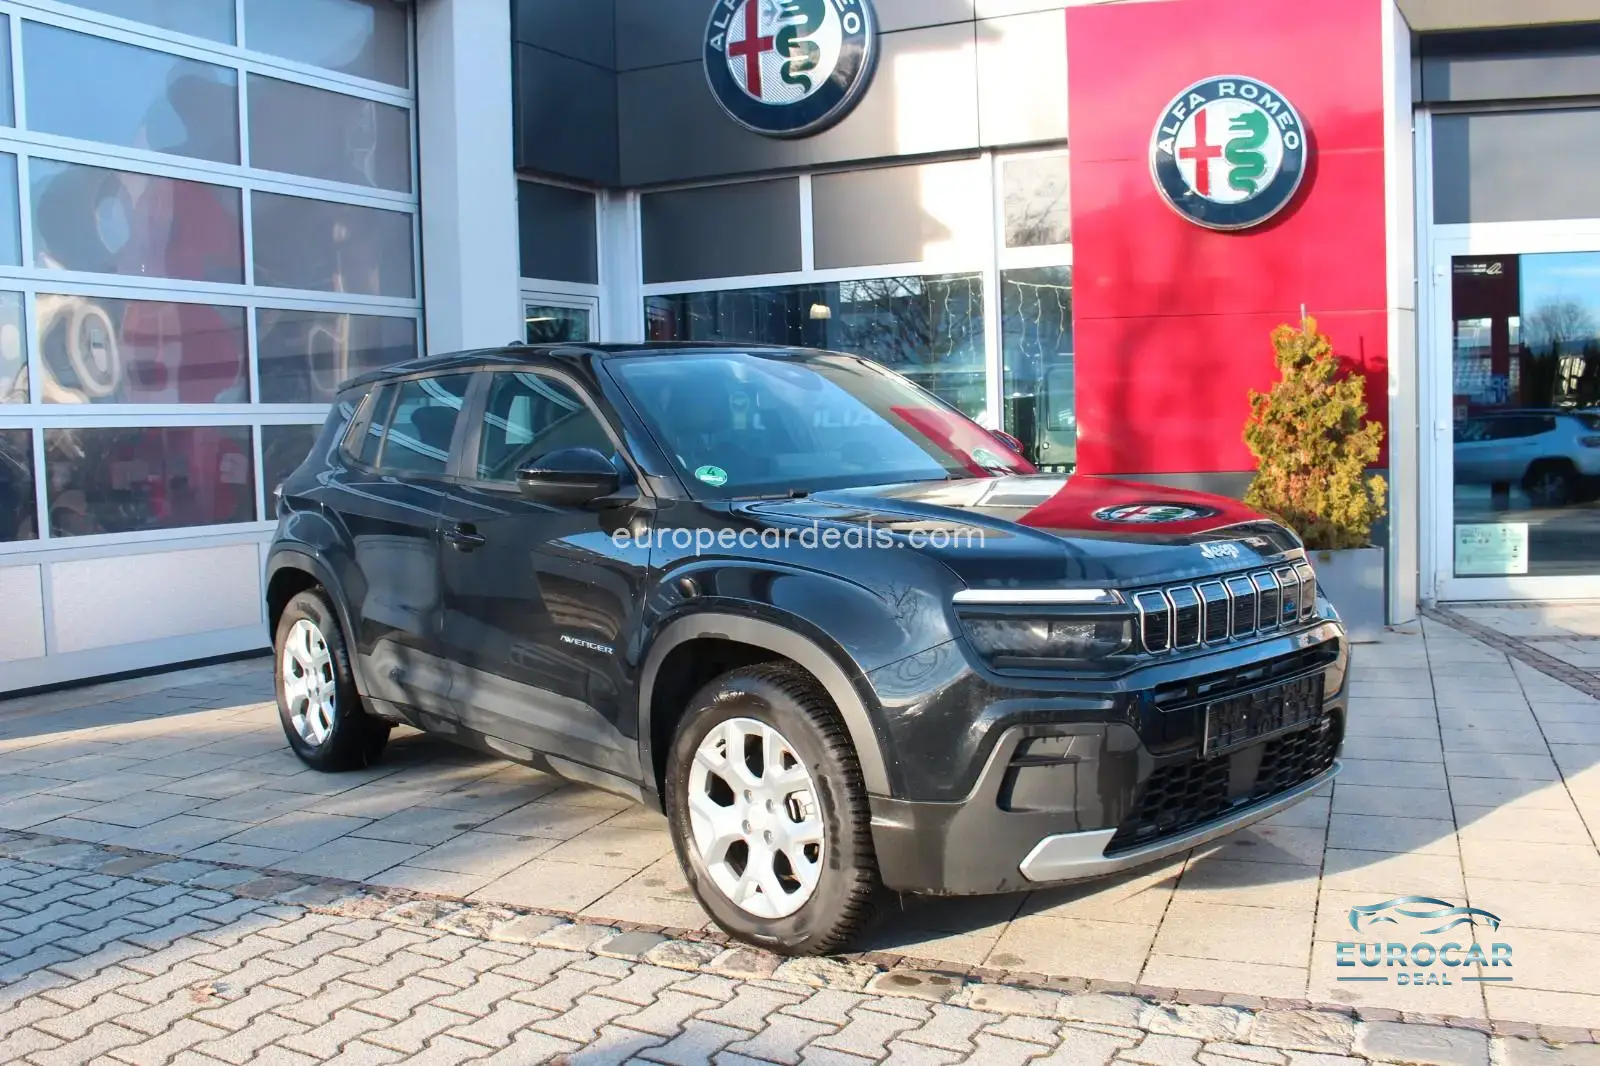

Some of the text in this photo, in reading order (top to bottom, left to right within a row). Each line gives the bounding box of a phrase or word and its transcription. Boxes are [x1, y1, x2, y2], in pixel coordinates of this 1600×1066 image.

[710, 0, 736, 52] ALF
[1159, 82, 1300, 155] ALFA ROMEO
[1200, 542, 1240, 559] Jeep
[560, 634, 614, 655] AVENGER
